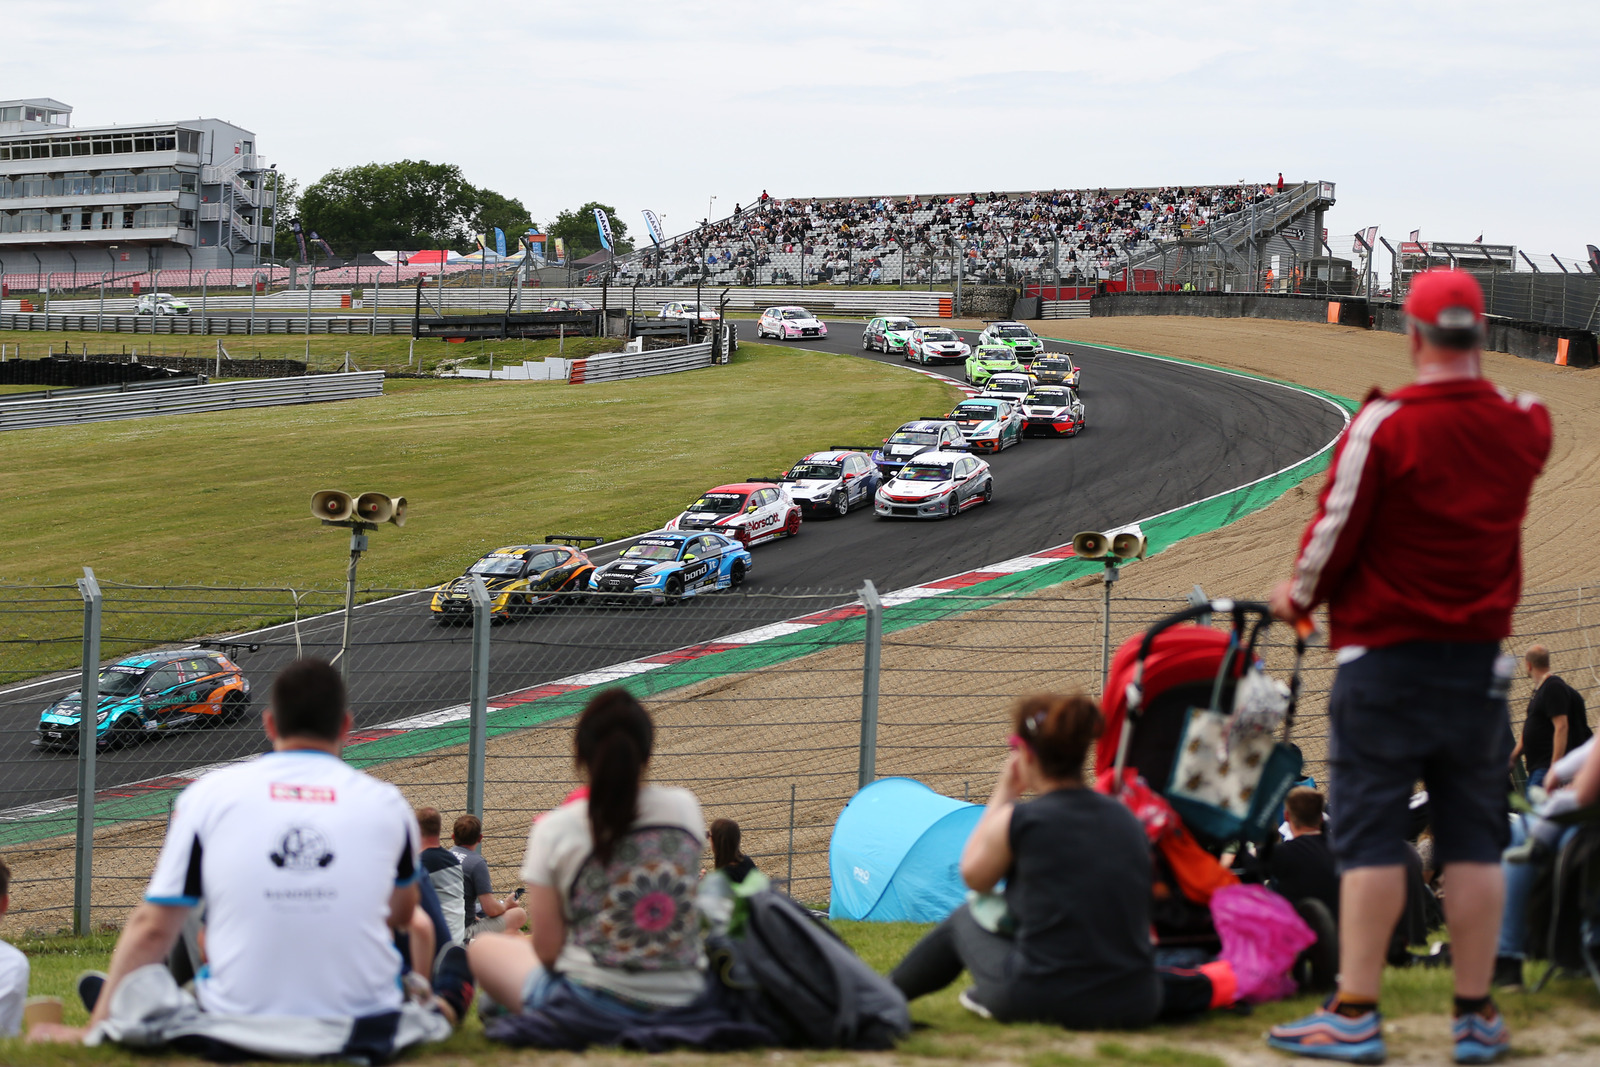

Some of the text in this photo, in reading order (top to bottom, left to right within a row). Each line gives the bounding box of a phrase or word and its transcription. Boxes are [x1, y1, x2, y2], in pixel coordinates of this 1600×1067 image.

[684, 560, 717, 582] bond it
[191, 661, 198, 670] 5
